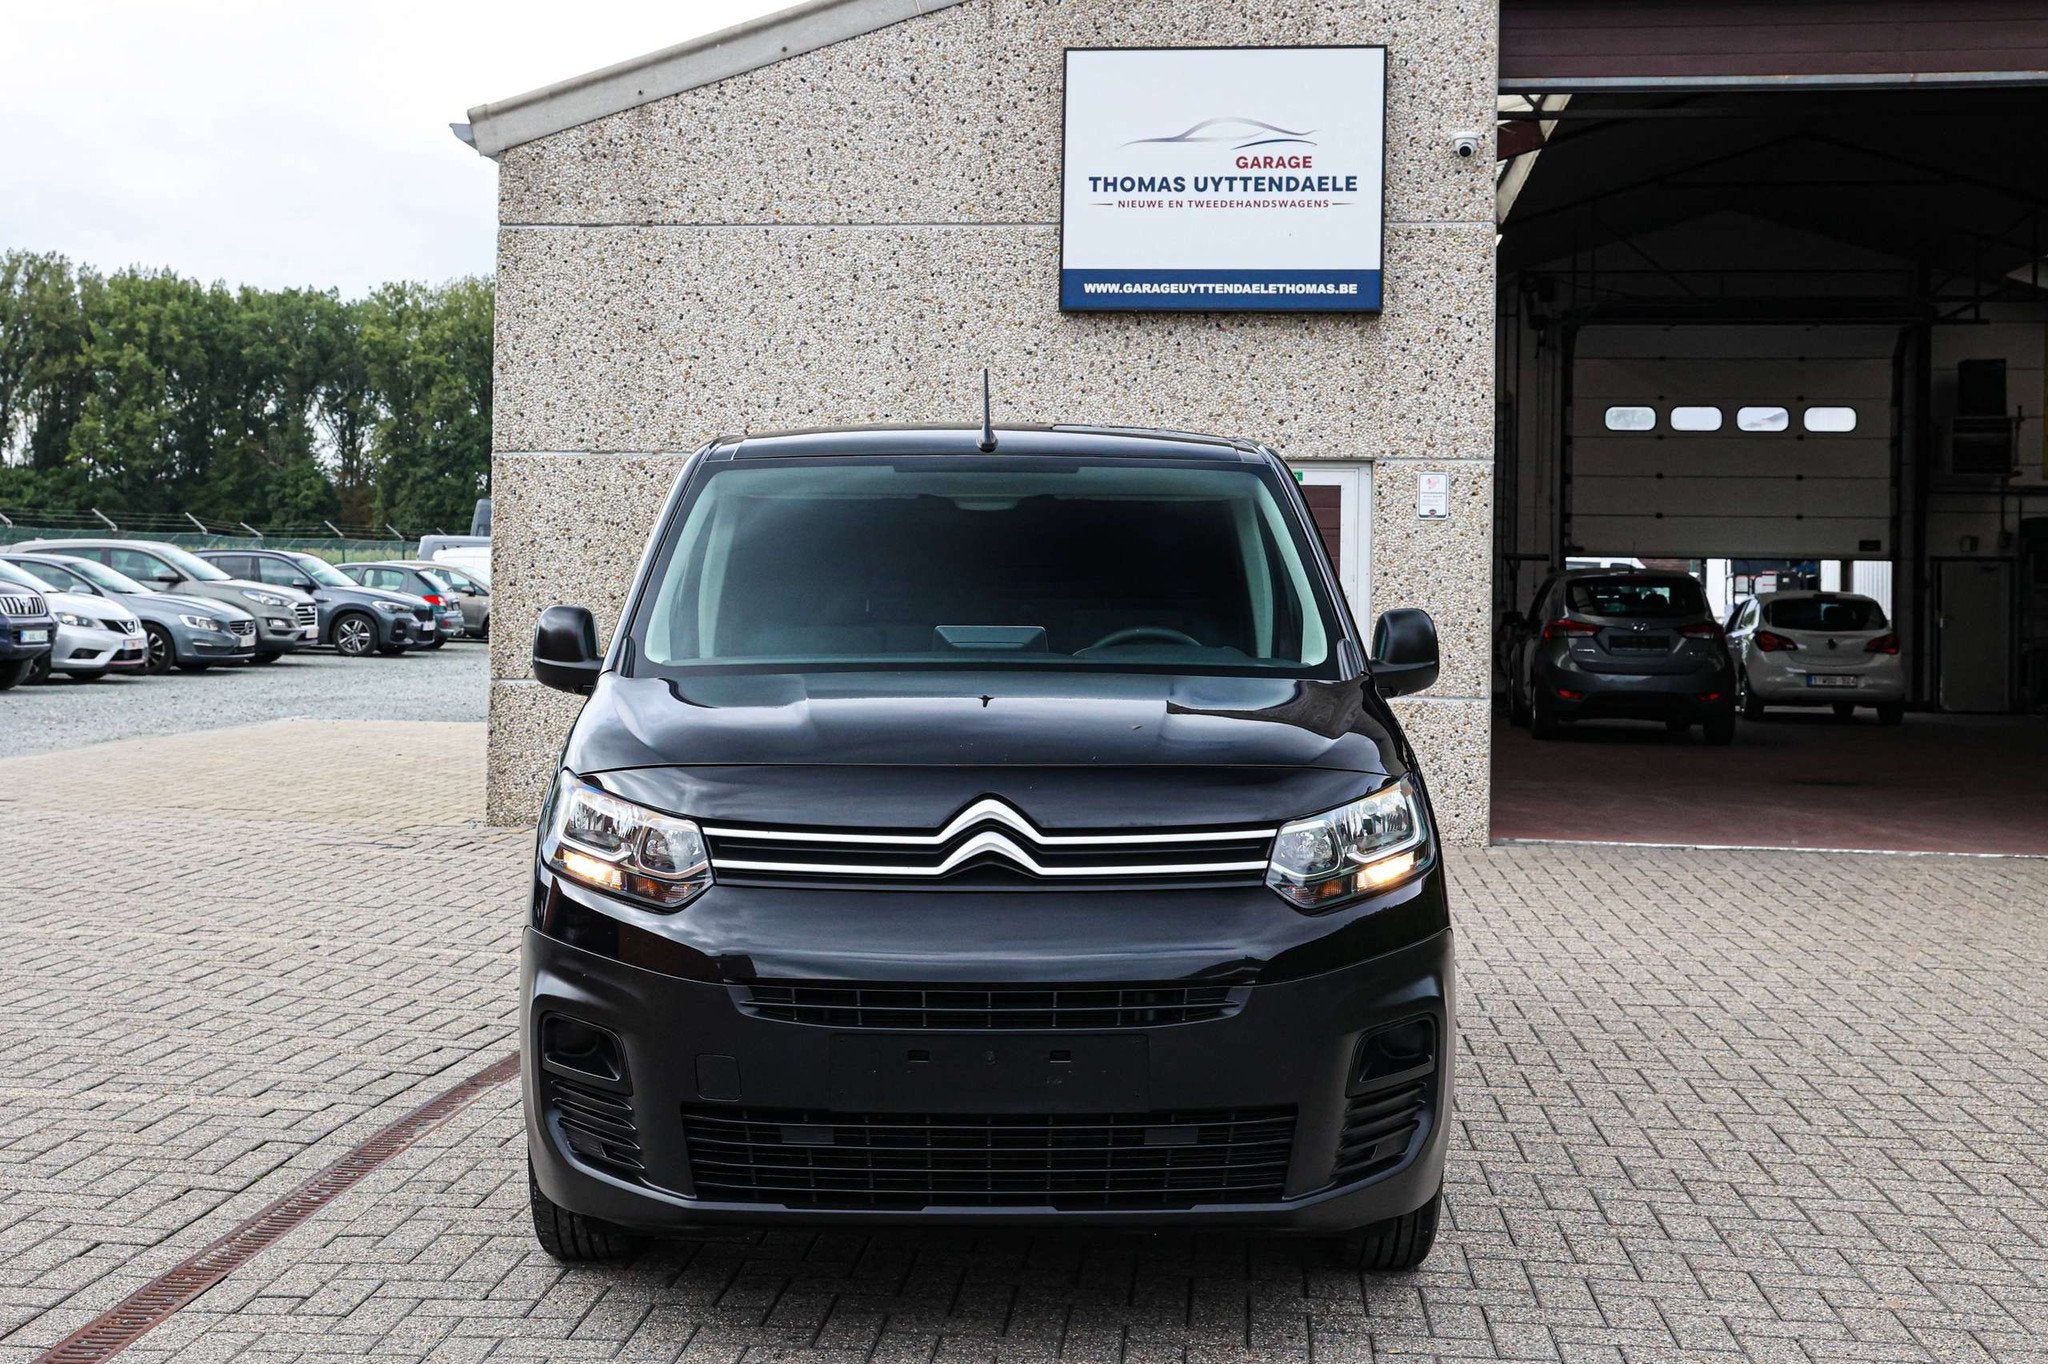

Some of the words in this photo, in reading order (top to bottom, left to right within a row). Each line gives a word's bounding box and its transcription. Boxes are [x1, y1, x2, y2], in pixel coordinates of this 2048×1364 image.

[1235, 155, 1313, 170] GARAGE
[1088, 175, 1186, 193] THOMAS
[1193, 175, 1358, 193] UYTTENDAELE
[1117, 199, 1164, 209] NIEUWE
[1168, 199, 1184, 209] EN
[1187, 199, 1330, 209] TWEEDEHANDSWAGENS
[1083, 282, 1358, 295] WWW.GARAGEUYTTENDAELETHOMAS.BE
